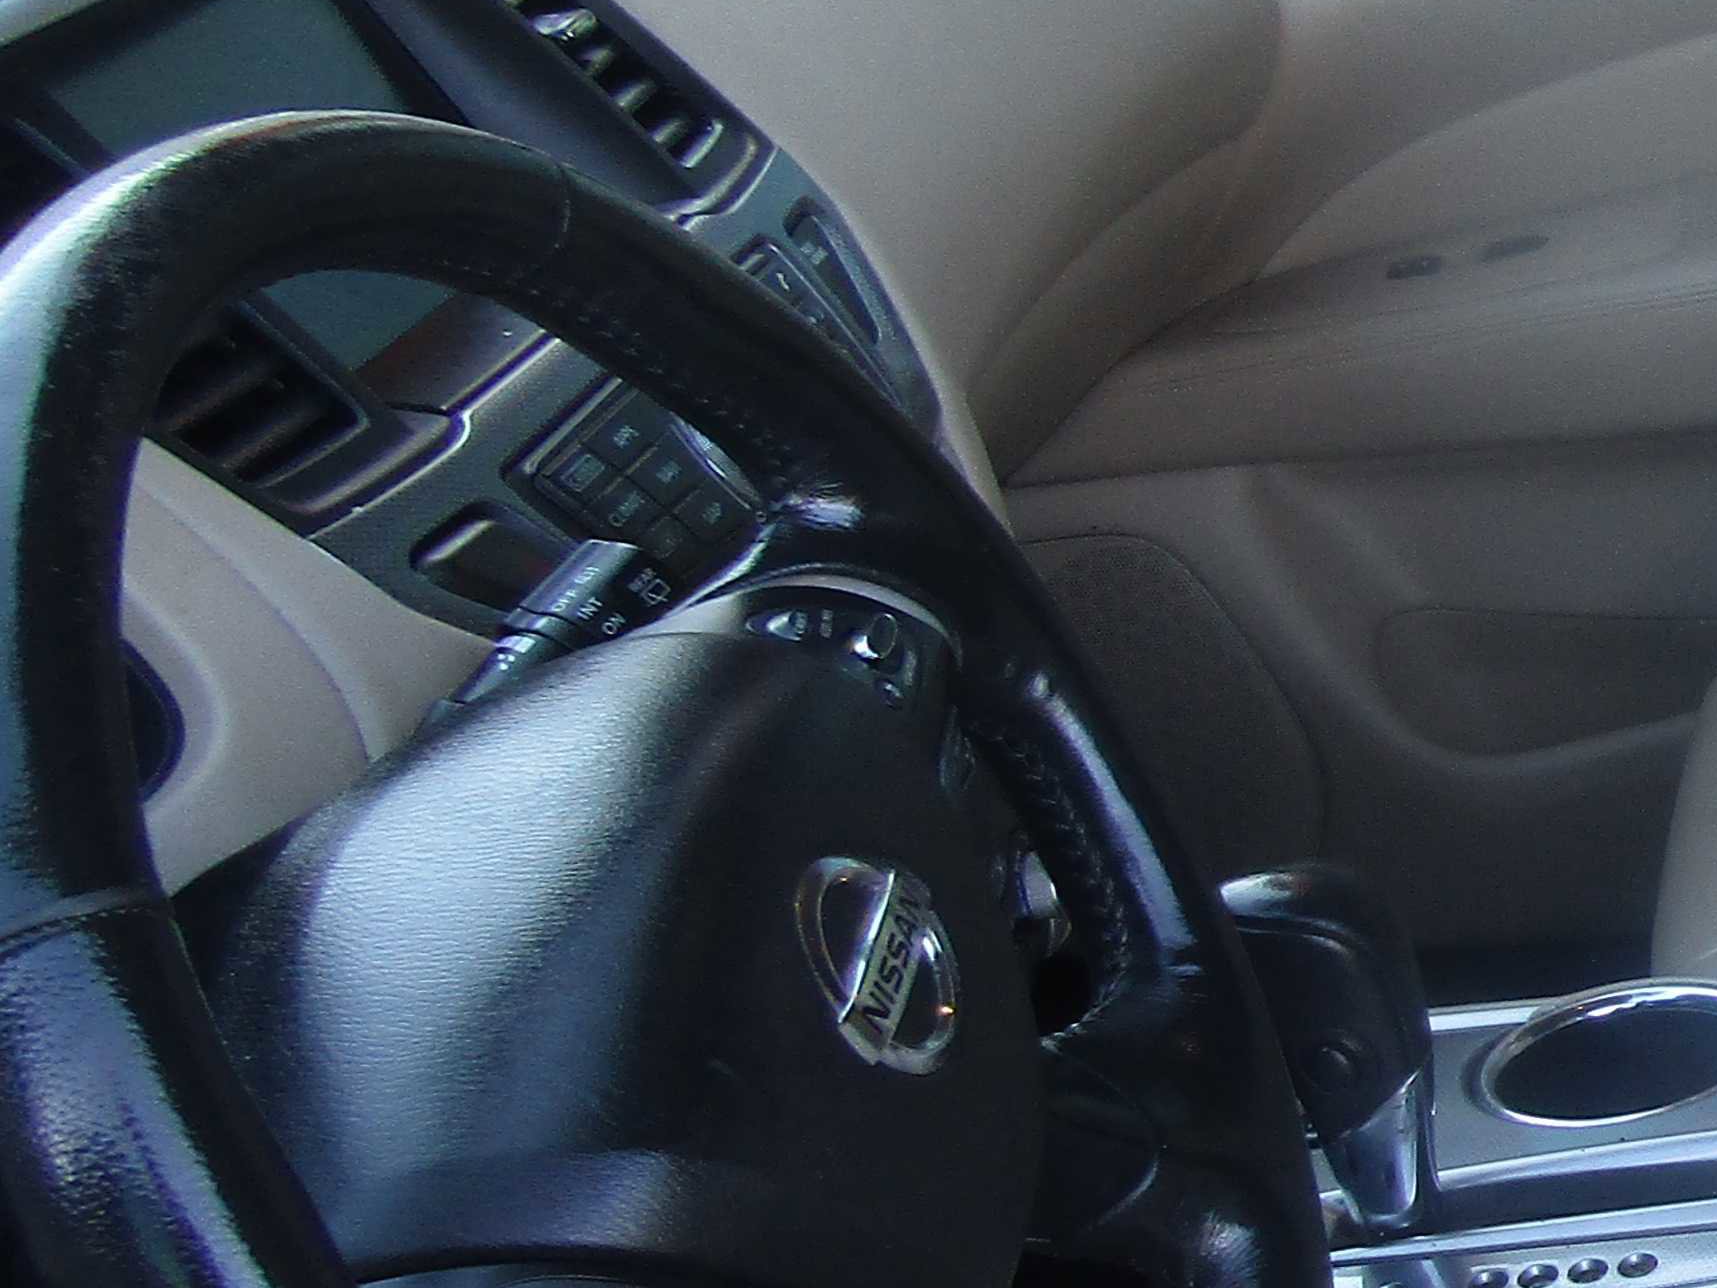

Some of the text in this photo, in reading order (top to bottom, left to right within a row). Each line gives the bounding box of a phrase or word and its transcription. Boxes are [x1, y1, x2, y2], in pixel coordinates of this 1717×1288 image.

[578, 596, 602, 620] INT
[603, 612, 626, 635] ON
[864, 890, 922, 1034] NISSAN
